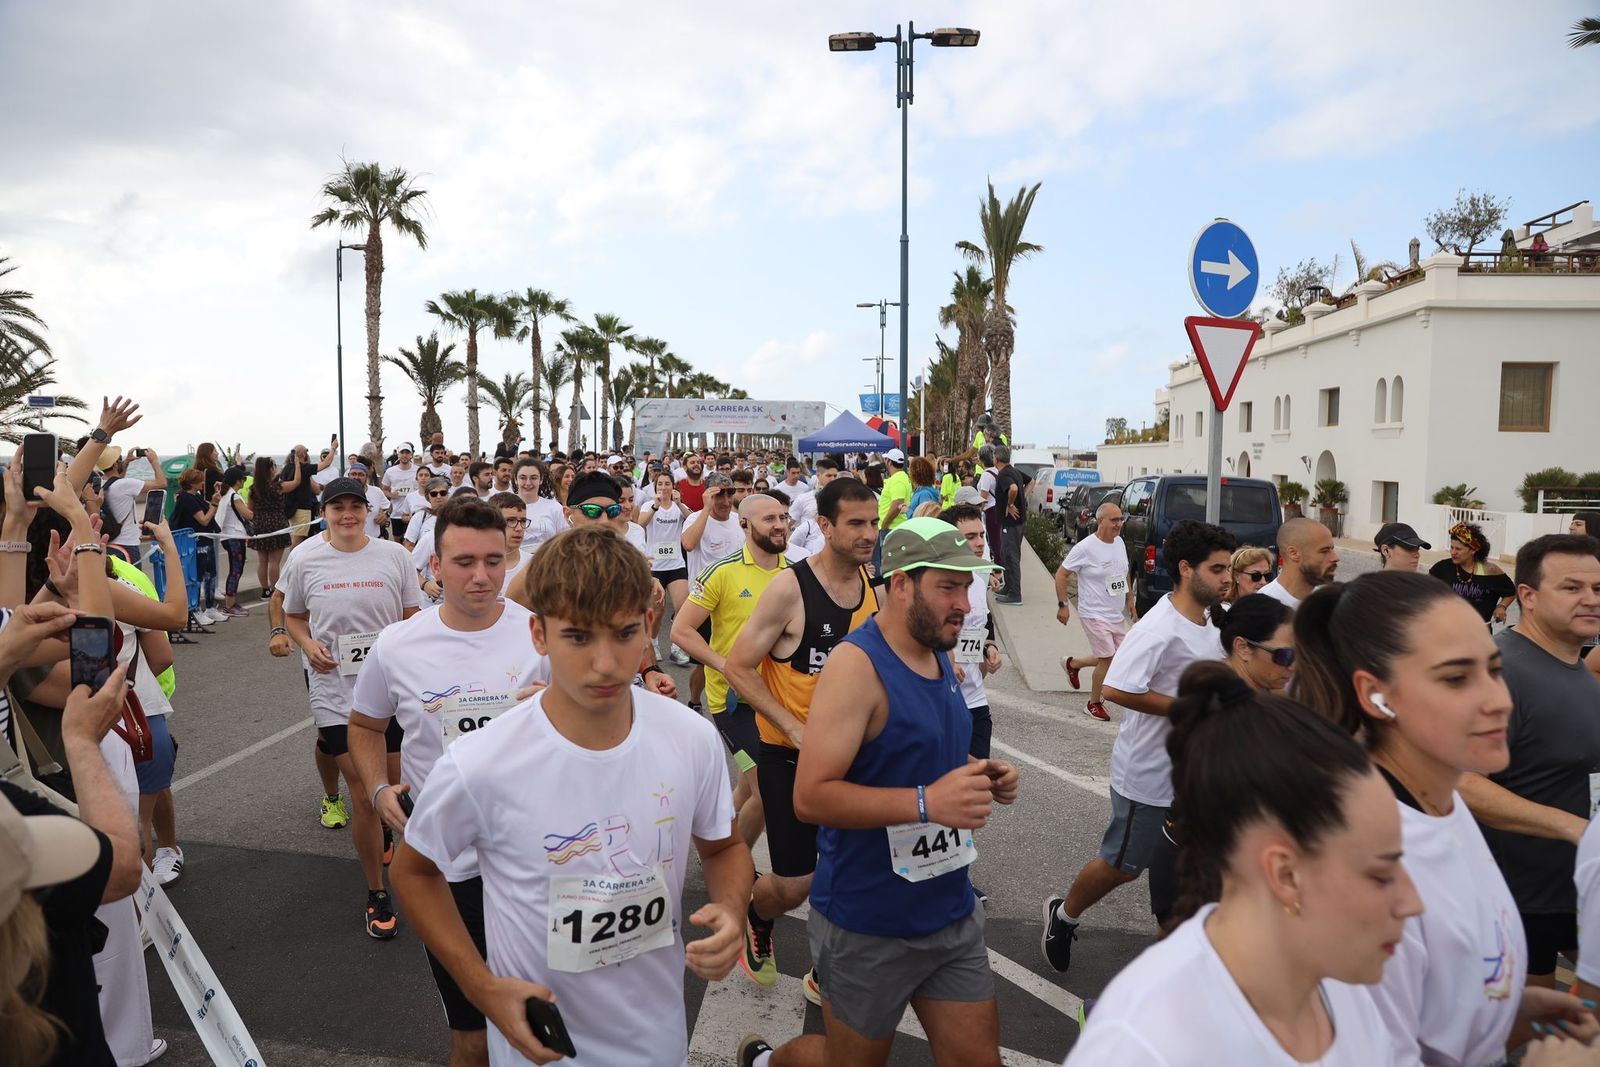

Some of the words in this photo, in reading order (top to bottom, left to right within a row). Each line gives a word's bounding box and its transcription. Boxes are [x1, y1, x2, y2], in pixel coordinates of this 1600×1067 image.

[816, 441, 877, 449] info@dorsalchip.es
[1111, 580, 1125, 590] 693
[960, 639, 980, 652] 774
[468, 695, 500, 703] CARRERA
[911, 827, 961, 859] 441
[583, 879, 596, 888] 3A
[599, 879, 644, 891] CARRERA
[646, 874, 656, 885] 5K
[562, 896, 666, 944] 1280
